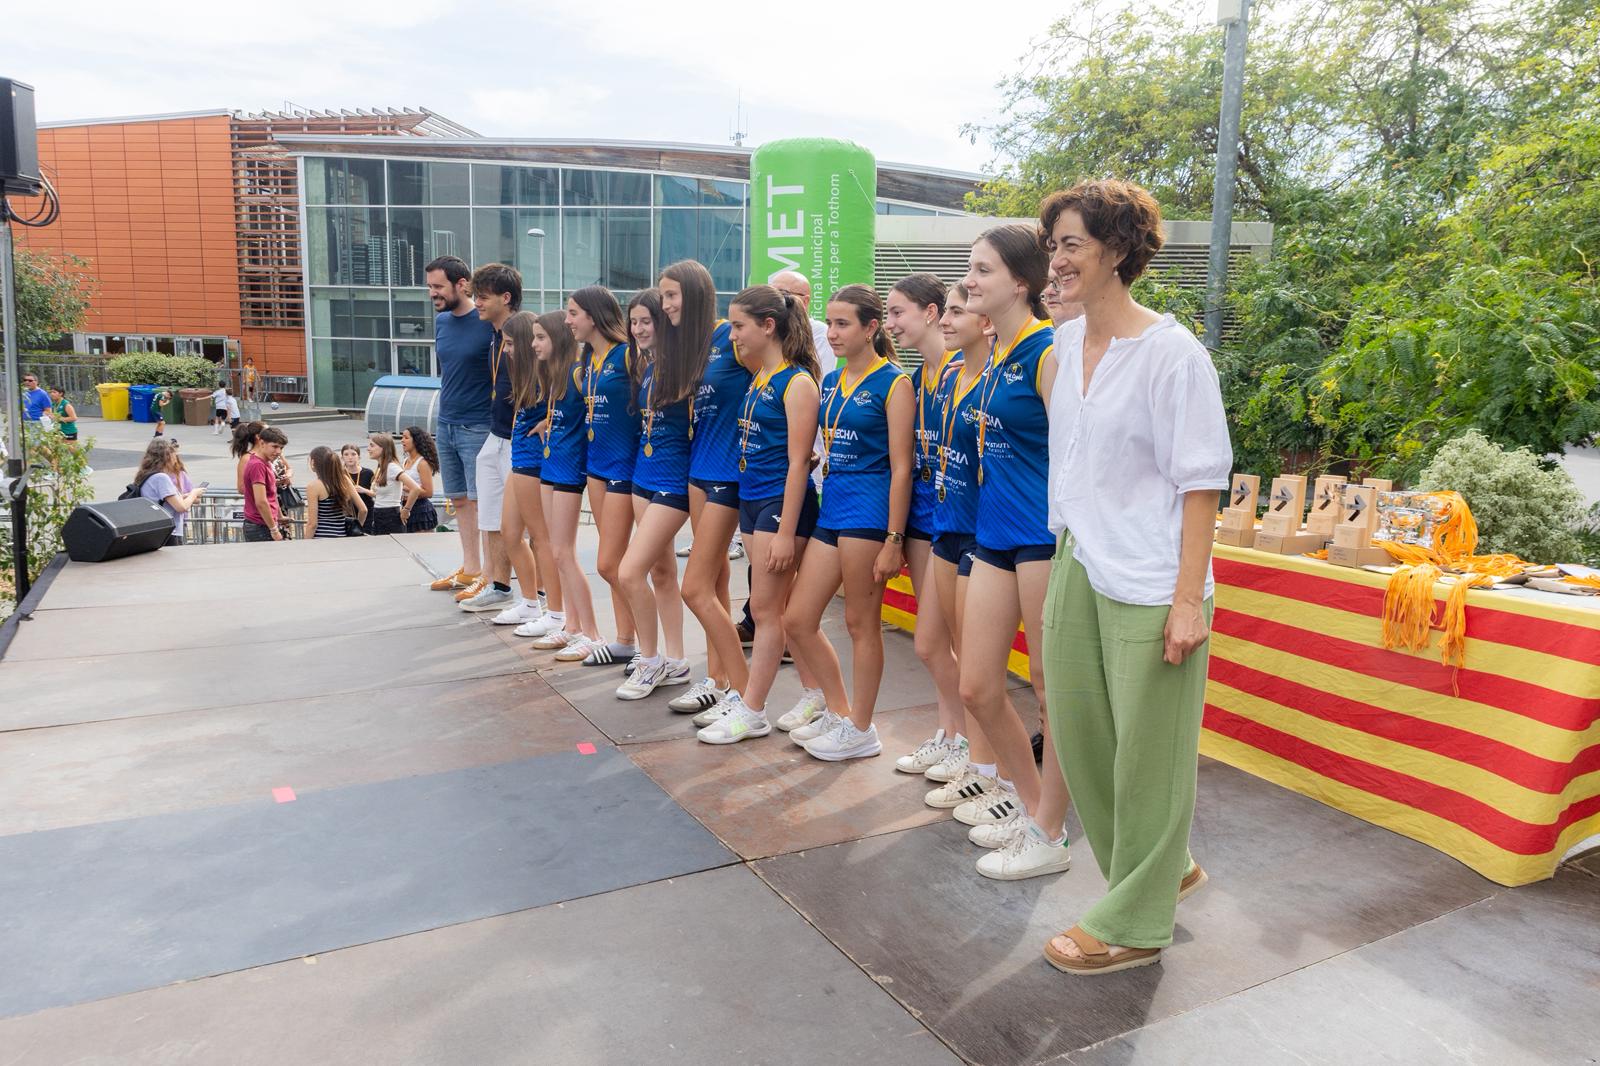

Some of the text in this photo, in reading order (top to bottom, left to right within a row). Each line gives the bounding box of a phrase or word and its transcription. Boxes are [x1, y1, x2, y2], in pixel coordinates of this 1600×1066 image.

[828, 174, 840, 226] Tothom
[767, 175, 804, 285] MET
[830, 242, 841, 263] per
[810, 214, 825, 320] ficina Municipal
[828, 267, 839, 293] orts
